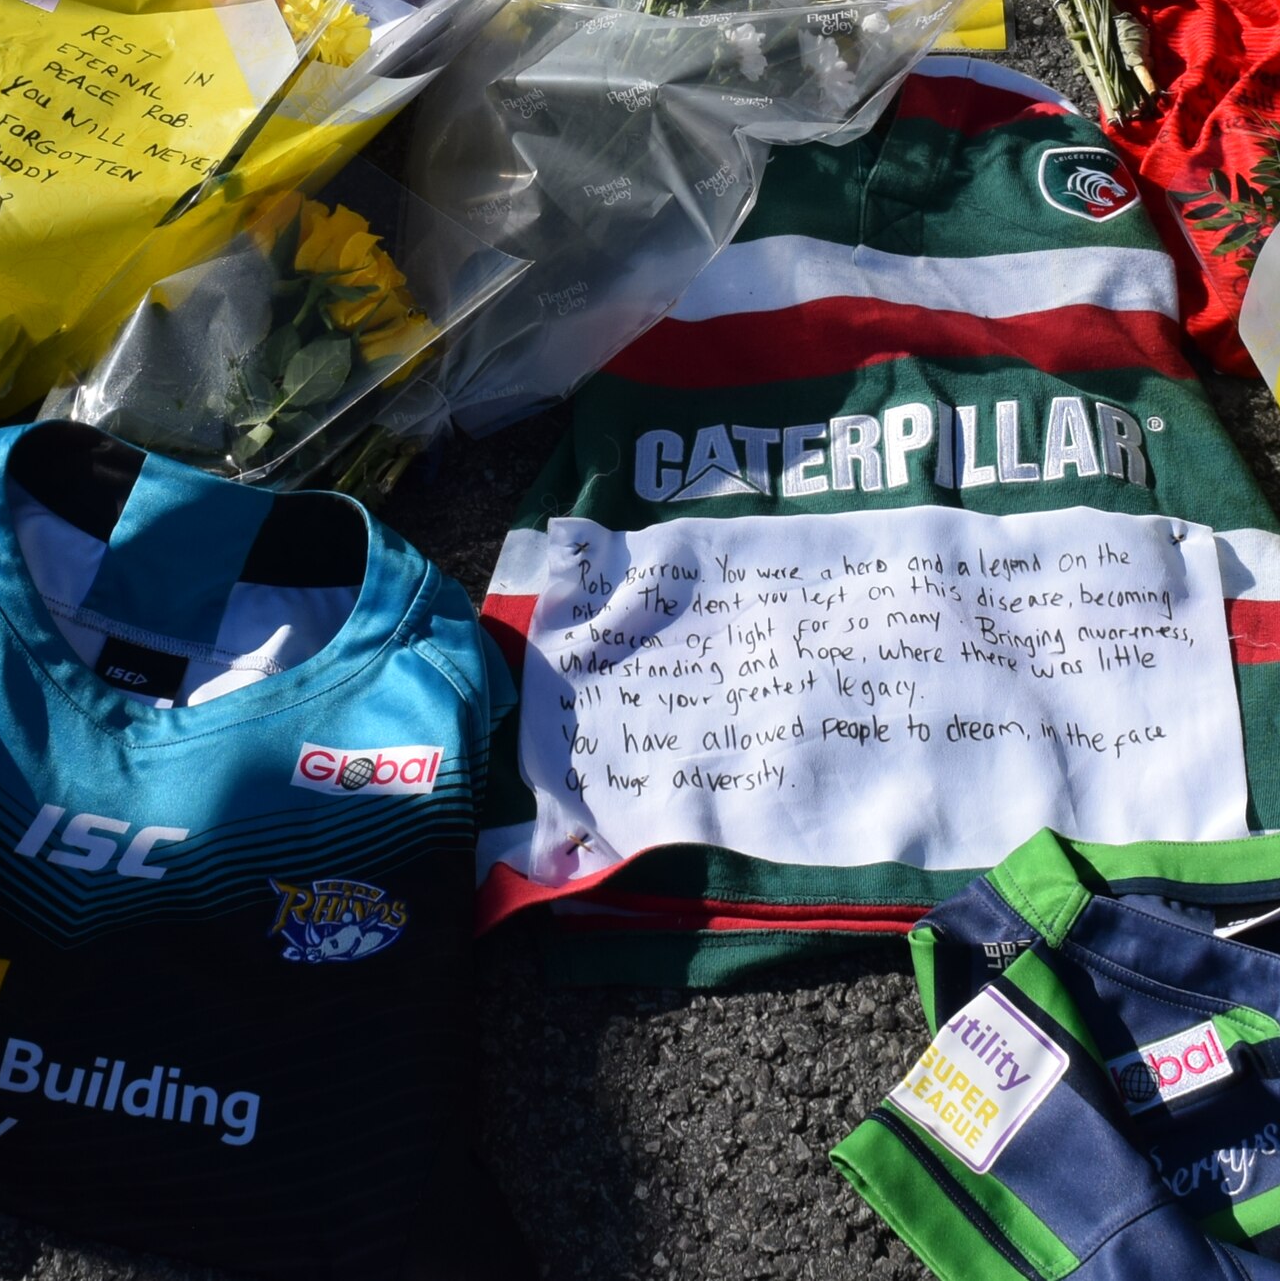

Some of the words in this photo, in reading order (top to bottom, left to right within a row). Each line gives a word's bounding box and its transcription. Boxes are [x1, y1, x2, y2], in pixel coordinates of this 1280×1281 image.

[56, 42, 163, 102] ETERNAL
[80, 24, 163, 64] REST
[183, 71, 215, 88] IN
[42, 60, 121, 107] PEACE
[607, 79, 658, 106] Flourish
[61, 106, 129, 148] WILL
[1053, 153, 1103, 164] LEICESTER
[583, 174, 633, 199] Flourish
[633, 396, 1150, 503] CATERPILLAR
[578, 559, 613, 596] Rob
[625, 563, 707, 585] Burrow.
[715, 553, 748, 585] You
[756, 565, 804, 582] were
[820, 568, 833, 581] a
[907, 552, 945, 577] and
[957, 559, 971, 577] a
[979, 547, 1042, 582] legend
[1097, 542, 1133, 568] the
[637, 583, 679, 616] The
[691, 590, 744, 615] dent
[758, 589, 789, 607] you
[800, 584, 848, 613] left
[868, 584, 896, 601] on
[910, 575, 963, 603] this
[976, 586, 1074, 614] disease,
[1079, 582, 1174, 621] becoming
[563, 630, 576, 642] a
[589, 622, 664, 650] beacon
[727, 616, 776, 655] light
[792, 618, 831, 643] for
[845, 615, 870, 634] so
[973, 615, 1067, 659] Bringing
[1077, 624, 1196, 649] awareness,
[738, 648, 781, 678] and
[796, 639, 868, 667] hope,
[878, 638, 946, 664] where
[960, 640, 1019, 673] there
[1030, 658, 1084, 680] was
[1097, 644, 1158, 672] little
[105, 664, 135, 685] ISC
[559, 684, 603, 712] will
[618, 685, 643, 708] be
[657, 691, 713, 715] your
[725, 668, 820, 717] greatest
[836, 667, 926, 708] legacy.
[561, 722, 600, 757] You
[621, 721, 683, 754] have
[701, 714, 806, 753] allowed
[906, 712, 932, 743] to
[945, 713, 1032, 744] dream,
[1040, 717, 1059, 743] in
[1065, 720, 1108, 754] the
[1112, 722, 1168, 760] face
[299, 749, 440, 792] Global
[606, 763, 651, 798] huge
[671, 758, 797, 793] adversity.
[13, 802, 190, 881] ISC
[271, 879, 409, 934] RHINOS
[920, 1044, 1000, 1129] SUPER
